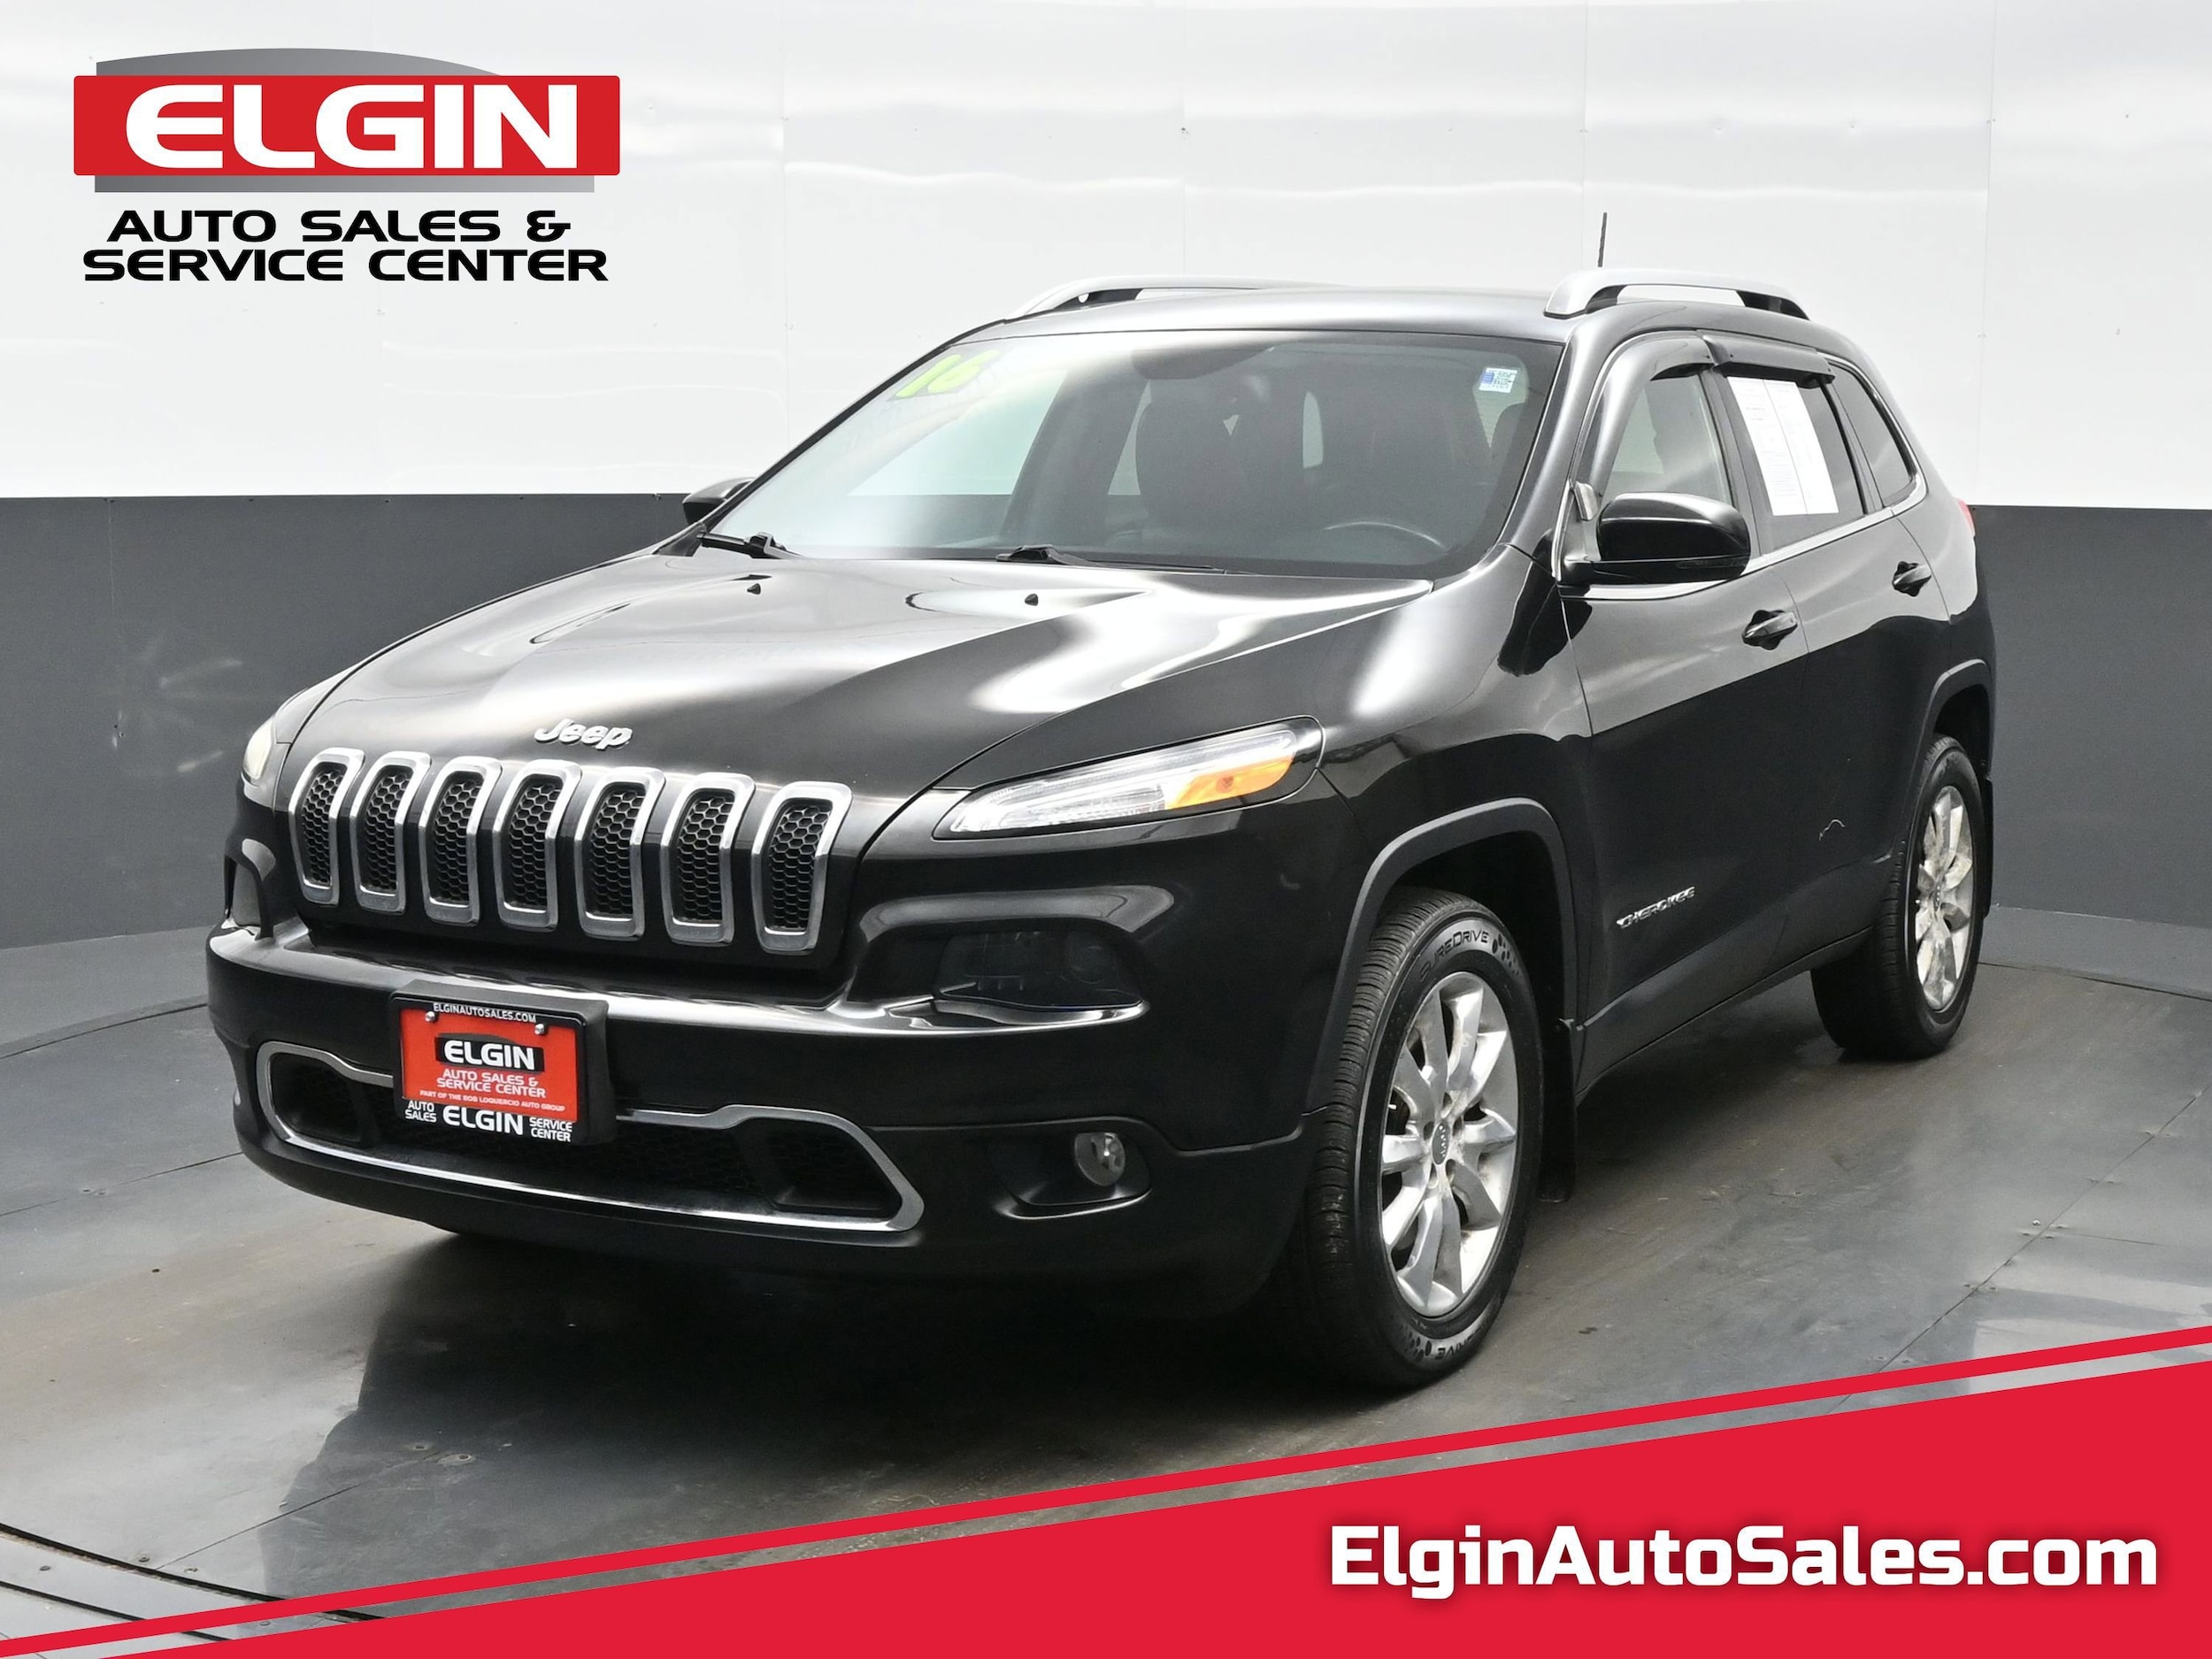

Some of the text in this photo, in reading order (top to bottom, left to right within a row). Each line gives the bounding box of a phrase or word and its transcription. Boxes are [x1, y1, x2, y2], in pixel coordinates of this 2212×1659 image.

[534, 718, 634, 750] Jeep
[433, 1002, 537, 1023] ELGINAUTOSALES.COM
[443, 1040, 536, 1071] ELGIN
[442, 1068, 539, 1087] AUTO SALES &
[436, 1077, 547, 1099] SERVICE CENTER
[404, 1109, 437, 1123] SALES
[407, 1100, 435, 1113] AUTO
[442, 1105, 524, 1136] ELGIN
[529, 1117, 573, 1133] SERVICE
[530, 1127, 572, 1142] CENTER
